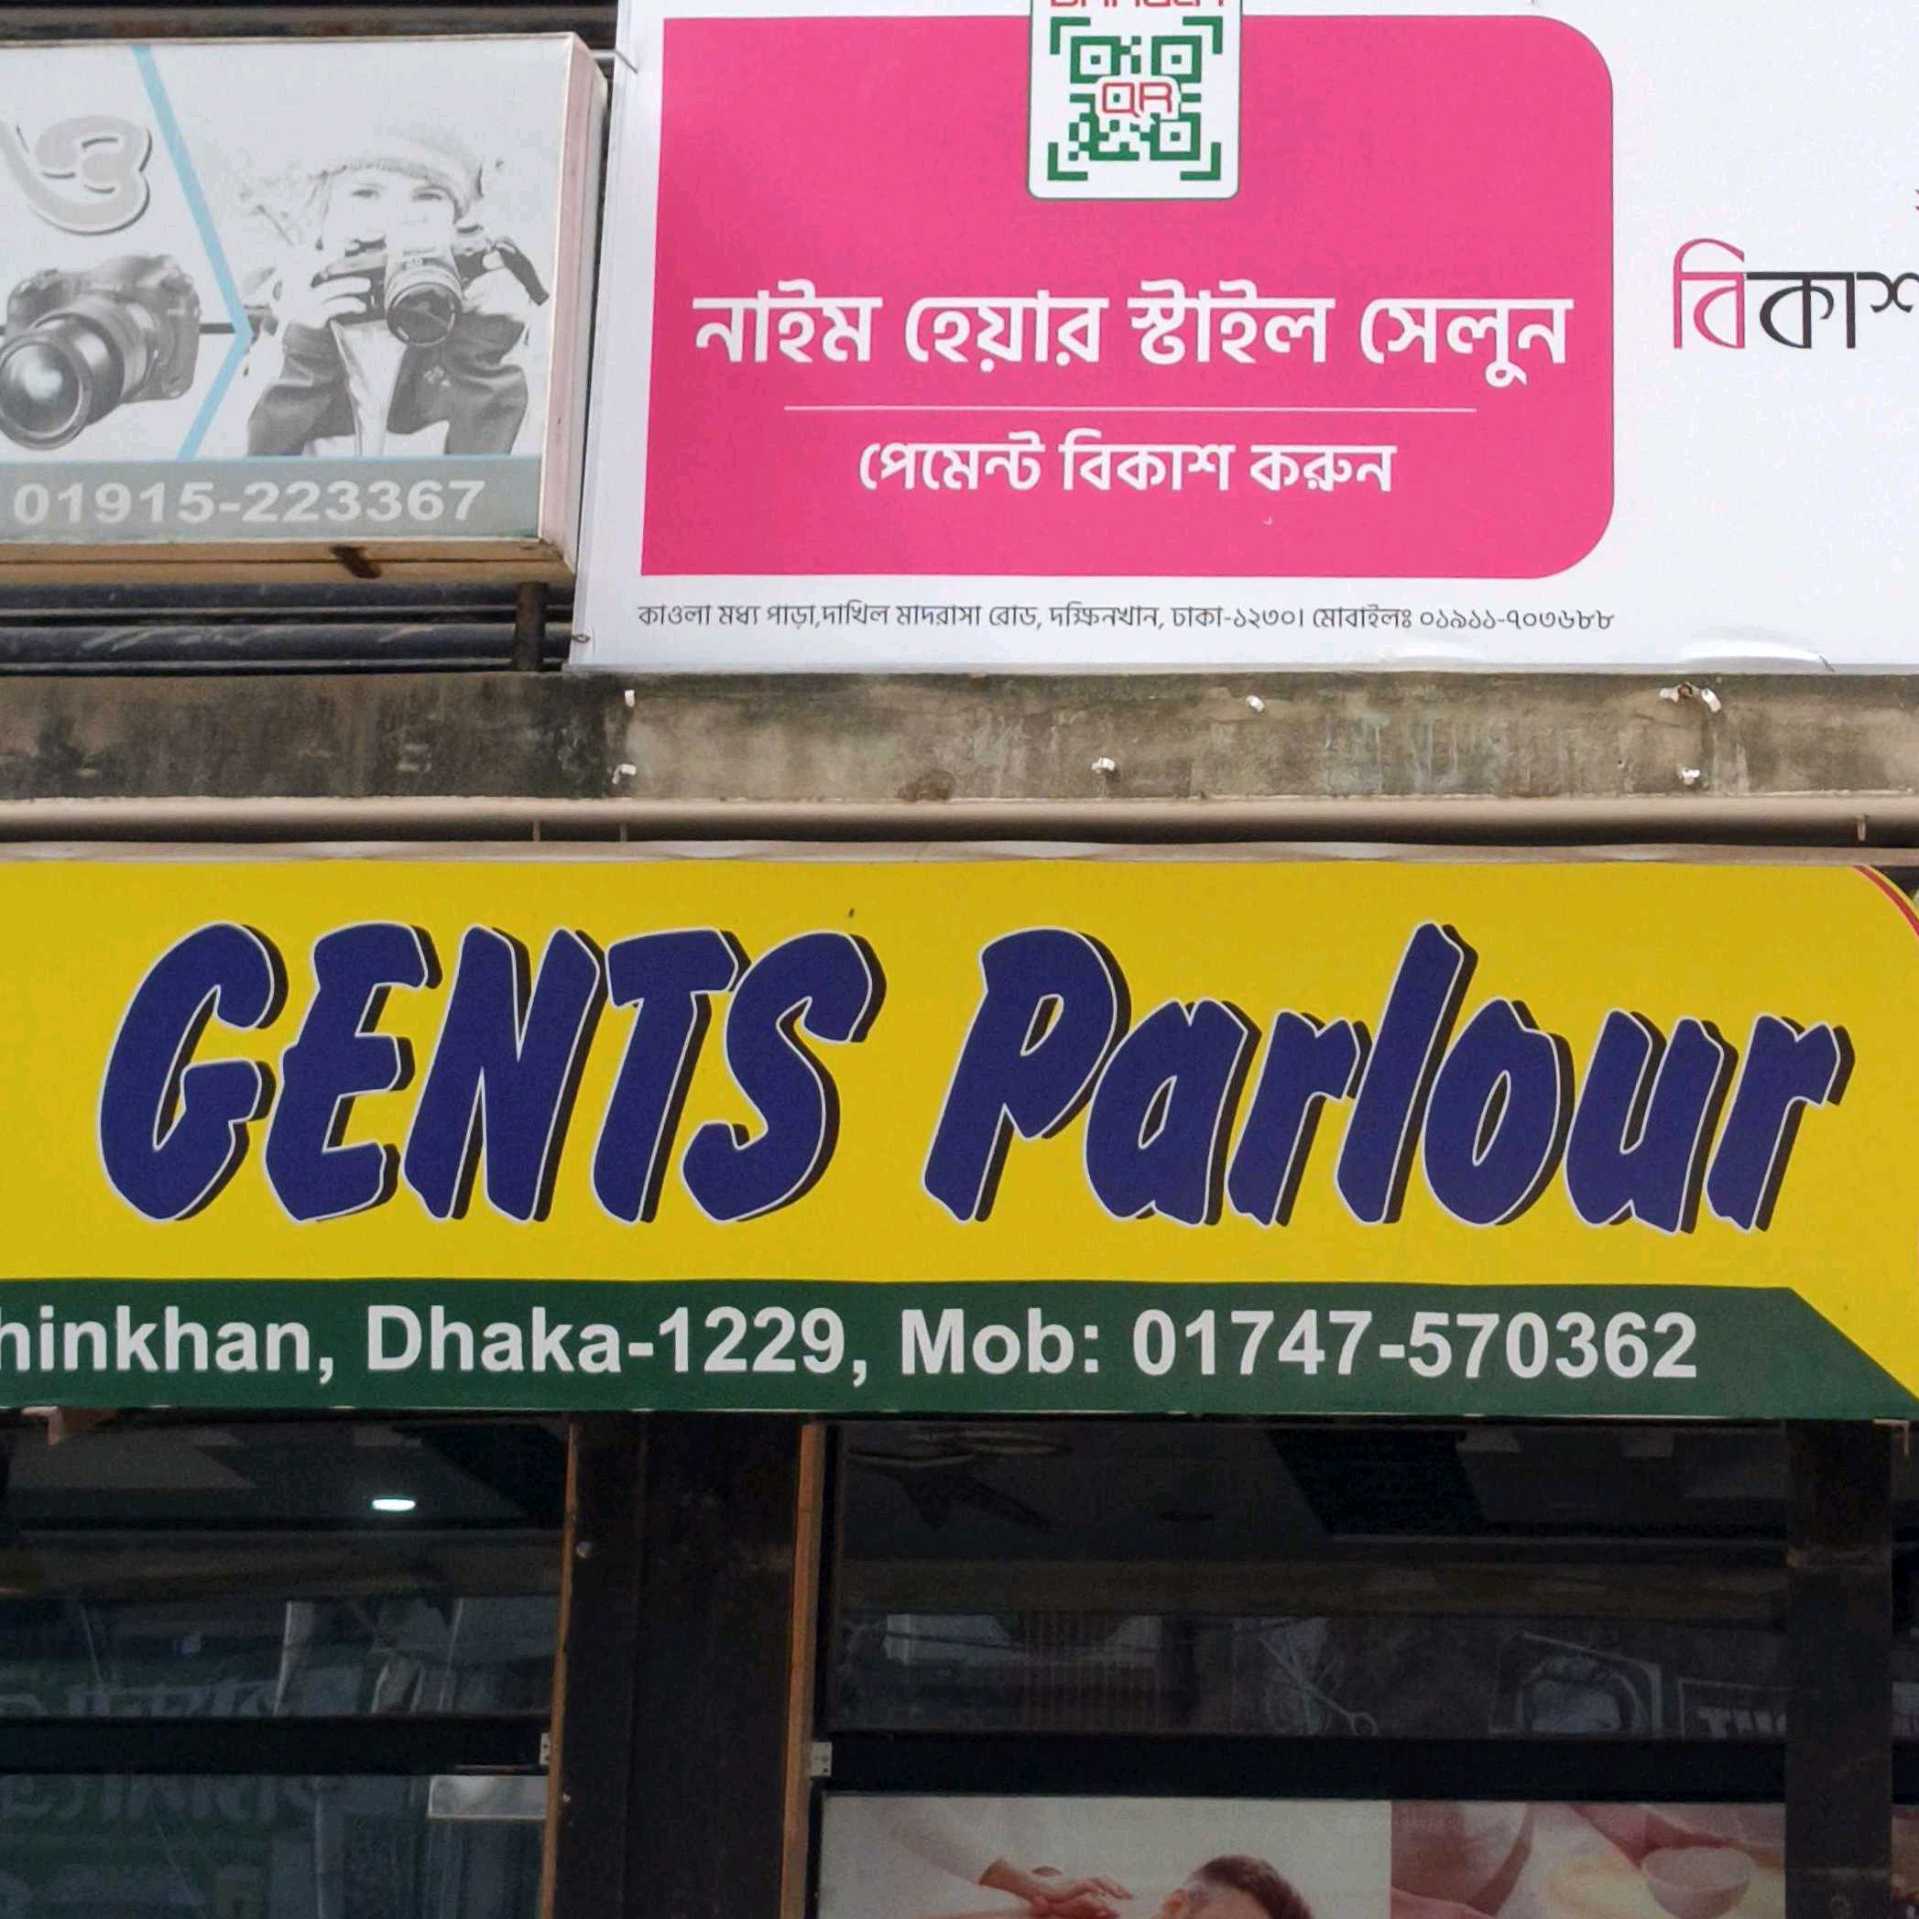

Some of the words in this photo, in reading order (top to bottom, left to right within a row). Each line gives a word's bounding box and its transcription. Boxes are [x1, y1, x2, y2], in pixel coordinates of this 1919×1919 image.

[1102, 82, 1173, 118] QR
[692, 279, 884, 362] নাইম
[904, 289, 1110, 372] হেয়ার
[1126, 279, 1336, 365] স্টাইল
[1360, 298, 1575, 388] সেলুন
[859, 430, 1046, 491] পেমেন্ট
[1058, 427, 1236, 491] বিকাশ
[1249, 444, 1398, 492] করুন
[13, 480, 486, 526] 01915-223367
[637, 604, 712, 626] কাওলা
[717, 604, 761, 626] মধ্য
[895, 604, 982, 626] মাদরাসা
[989, 604, 1042, 629] রোড,
[1420, 610, 1615, 630] ০১৯১১-৭০৩৬৮৮
[101, 922, 887, 1223] GENTS
[924, 922, 1856, 1234] Parlour
[367, 1304, 868, 1388] Dhaka-1229,
[901, 1307, 1100, 1376] Mob:
[1133, 1309, 1698, 1380] 01747-570362
